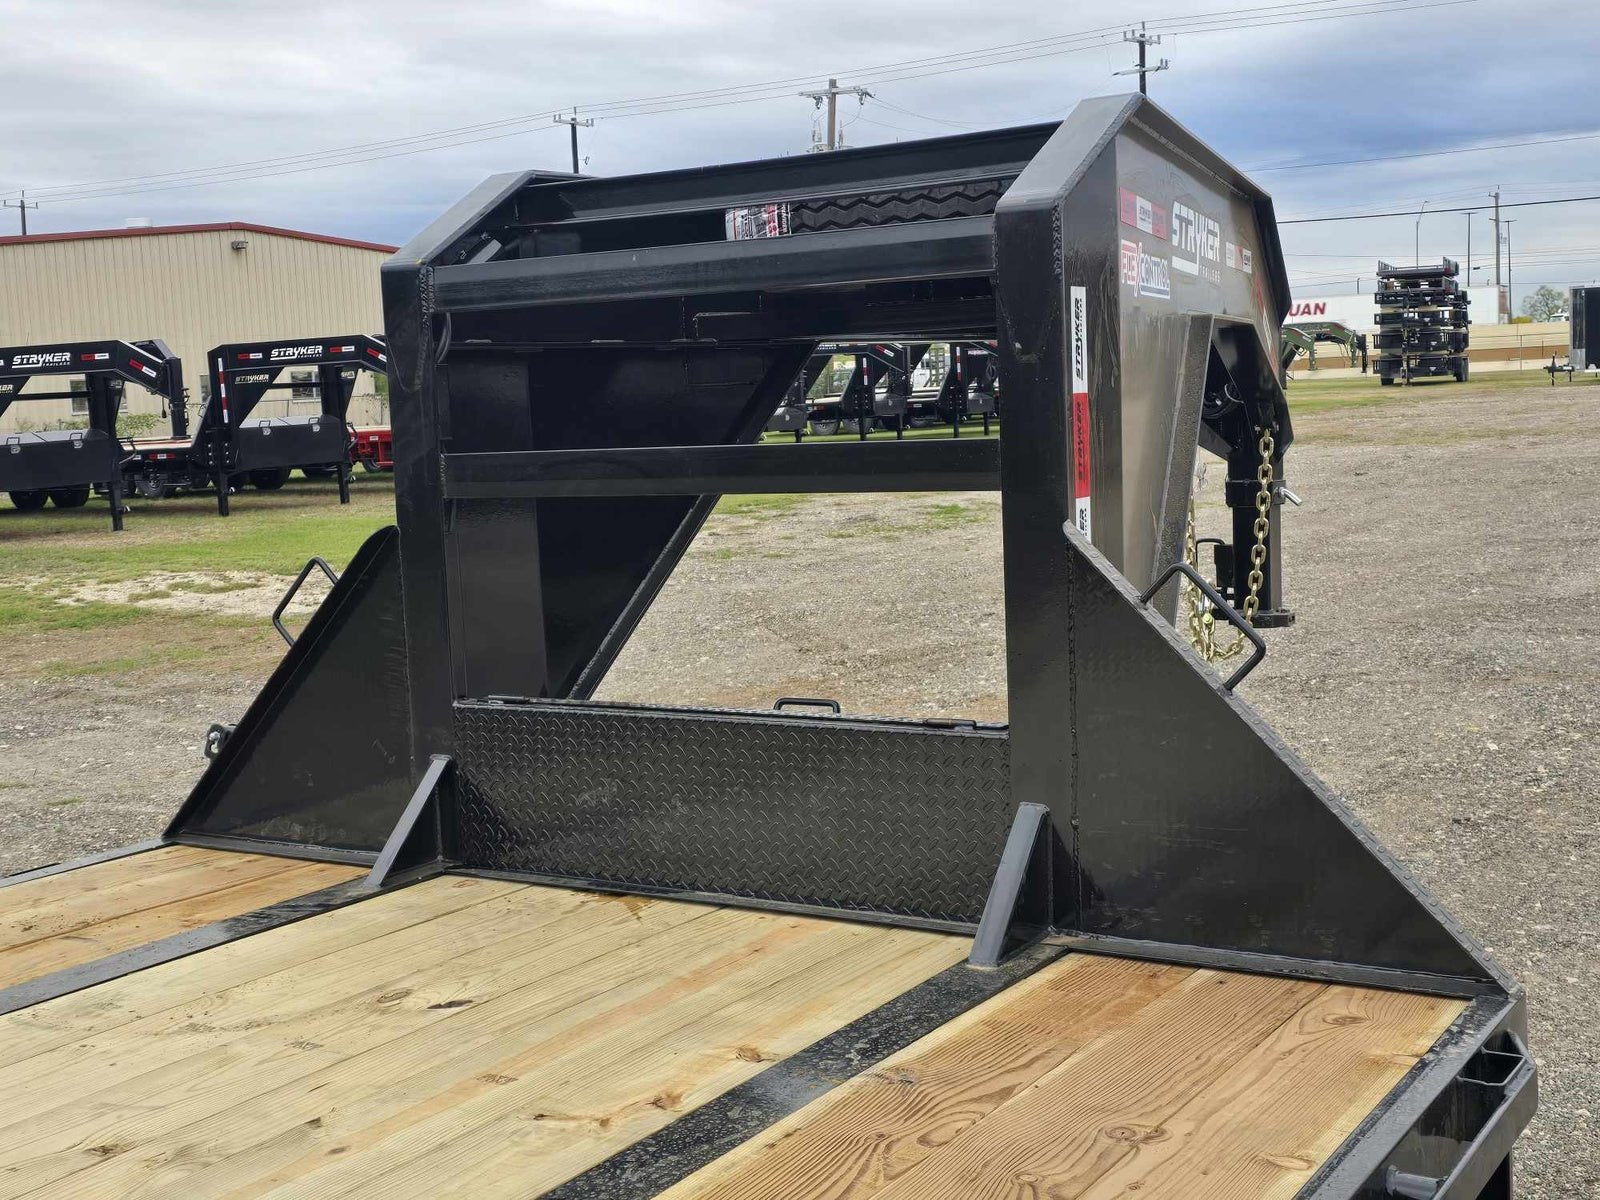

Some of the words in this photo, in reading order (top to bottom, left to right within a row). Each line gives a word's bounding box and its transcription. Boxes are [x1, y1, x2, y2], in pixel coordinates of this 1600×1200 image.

[1171, 200, 1220, 276] STRYKER
[1289, 302, 1327, 317] UAN
[1074, 297, 1083, 381] STRYKER
[11, 352, 71, 369] STRYKER
[270, 345, 323, 361] STRYKER
[235, 374, 270, 385] STRYKER
[1076, 401, 1084, 481] STRYKER
